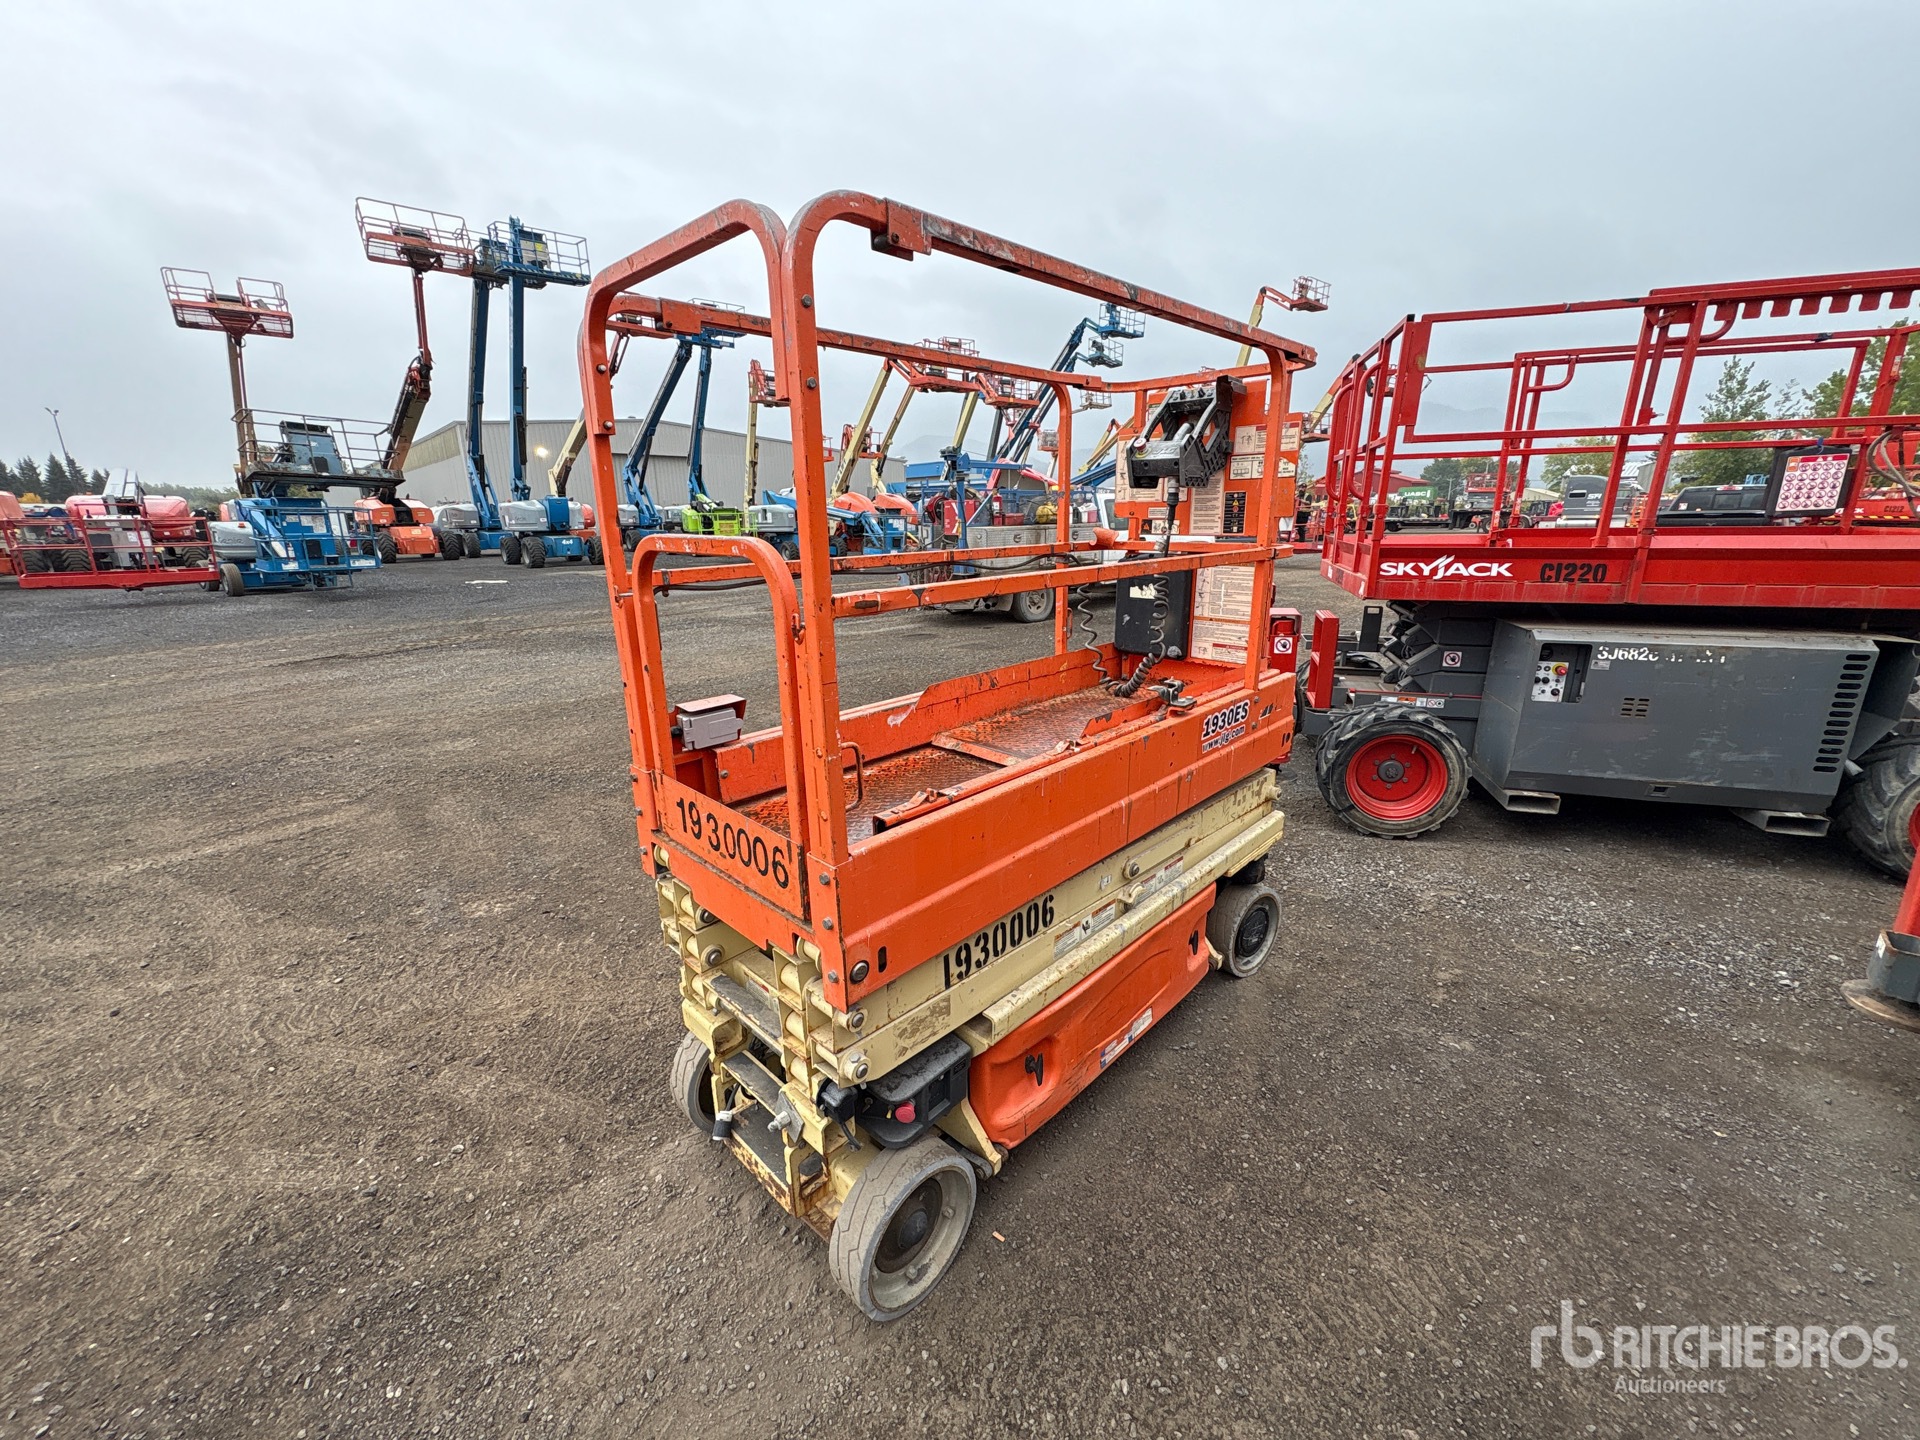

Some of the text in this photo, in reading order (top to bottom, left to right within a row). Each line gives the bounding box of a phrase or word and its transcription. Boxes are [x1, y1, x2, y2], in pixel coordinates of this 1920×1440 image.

[1379, 554, 1514, 580] SKYJACK
[1202, 701, 1250, 739] 1930ES
[676, 797, 789, 889] 1930006
[943, 894, 1055, 990] 1930006
